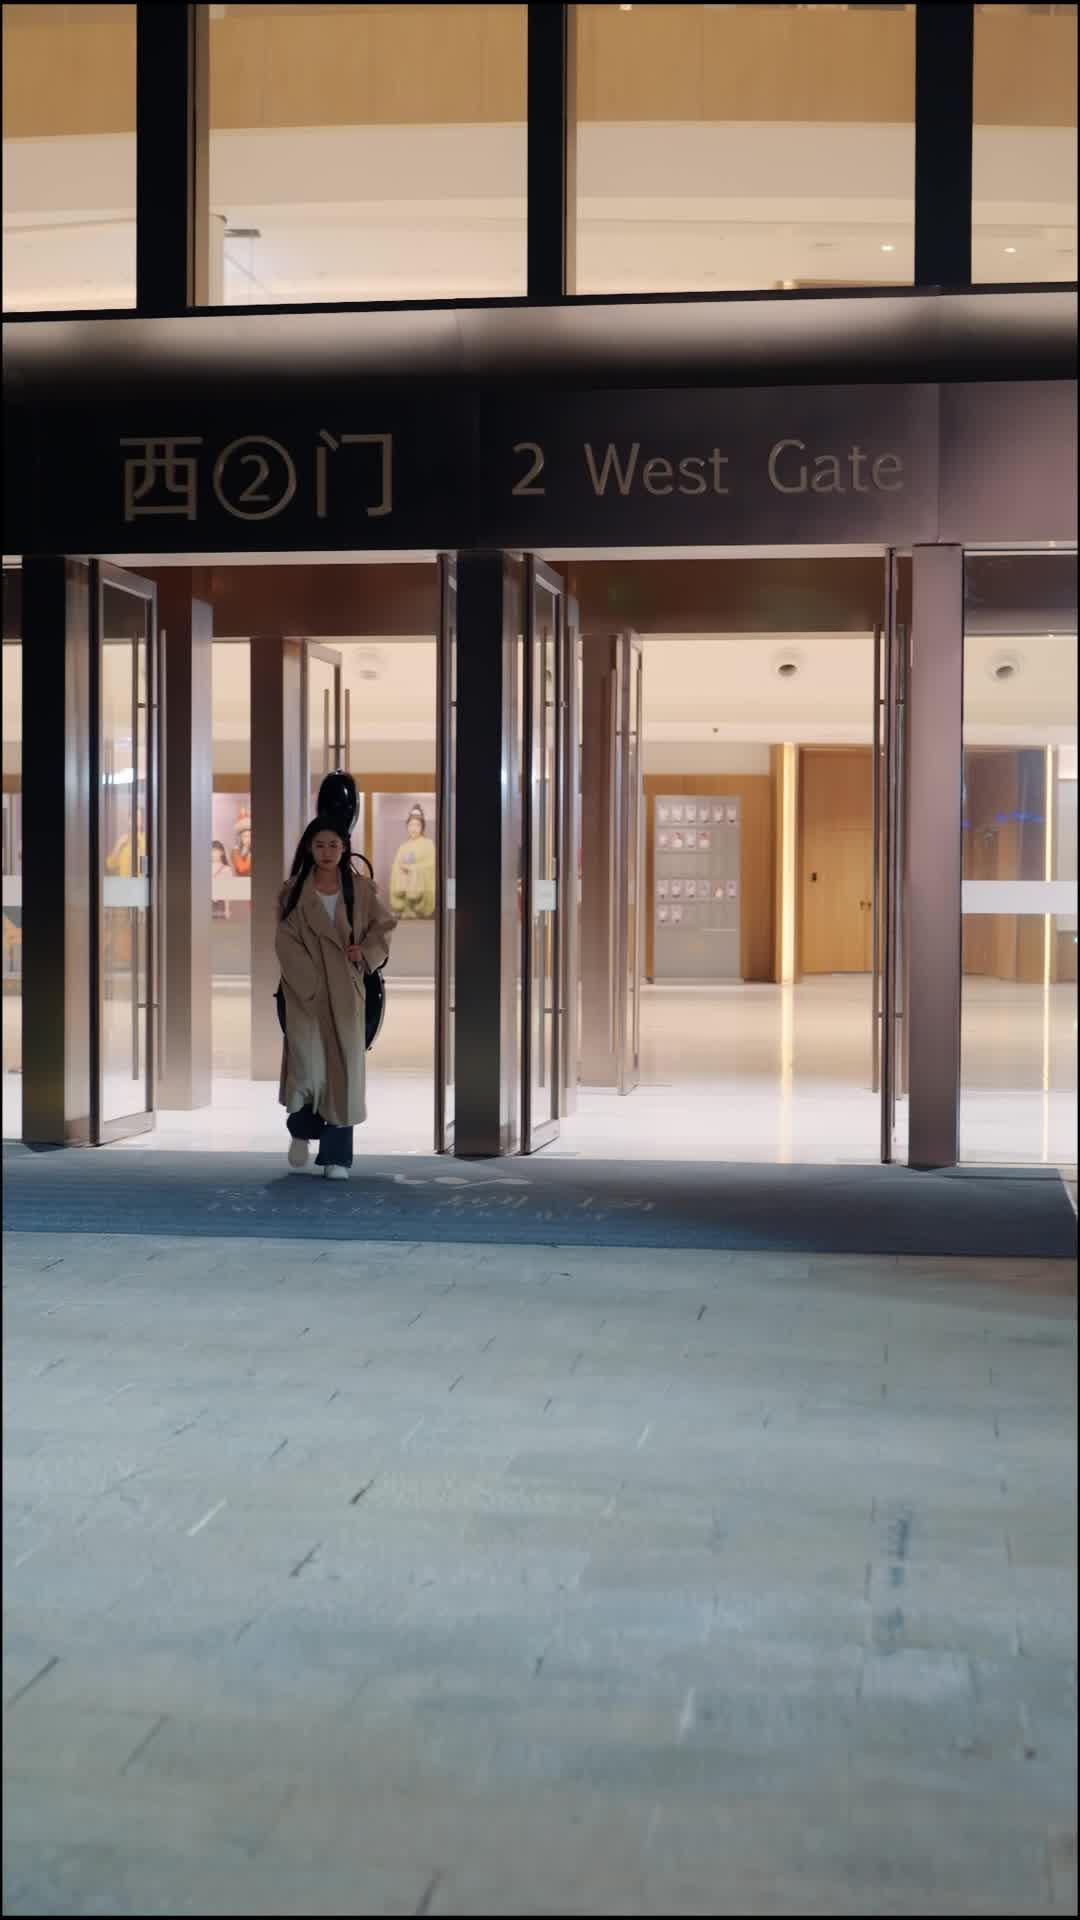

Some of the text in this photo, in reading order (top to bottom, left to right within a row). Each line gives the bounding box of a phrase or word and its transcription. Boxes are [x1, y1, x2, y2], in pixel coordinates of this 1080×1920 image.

[510, 438, 905, 497] 2 West Gate
